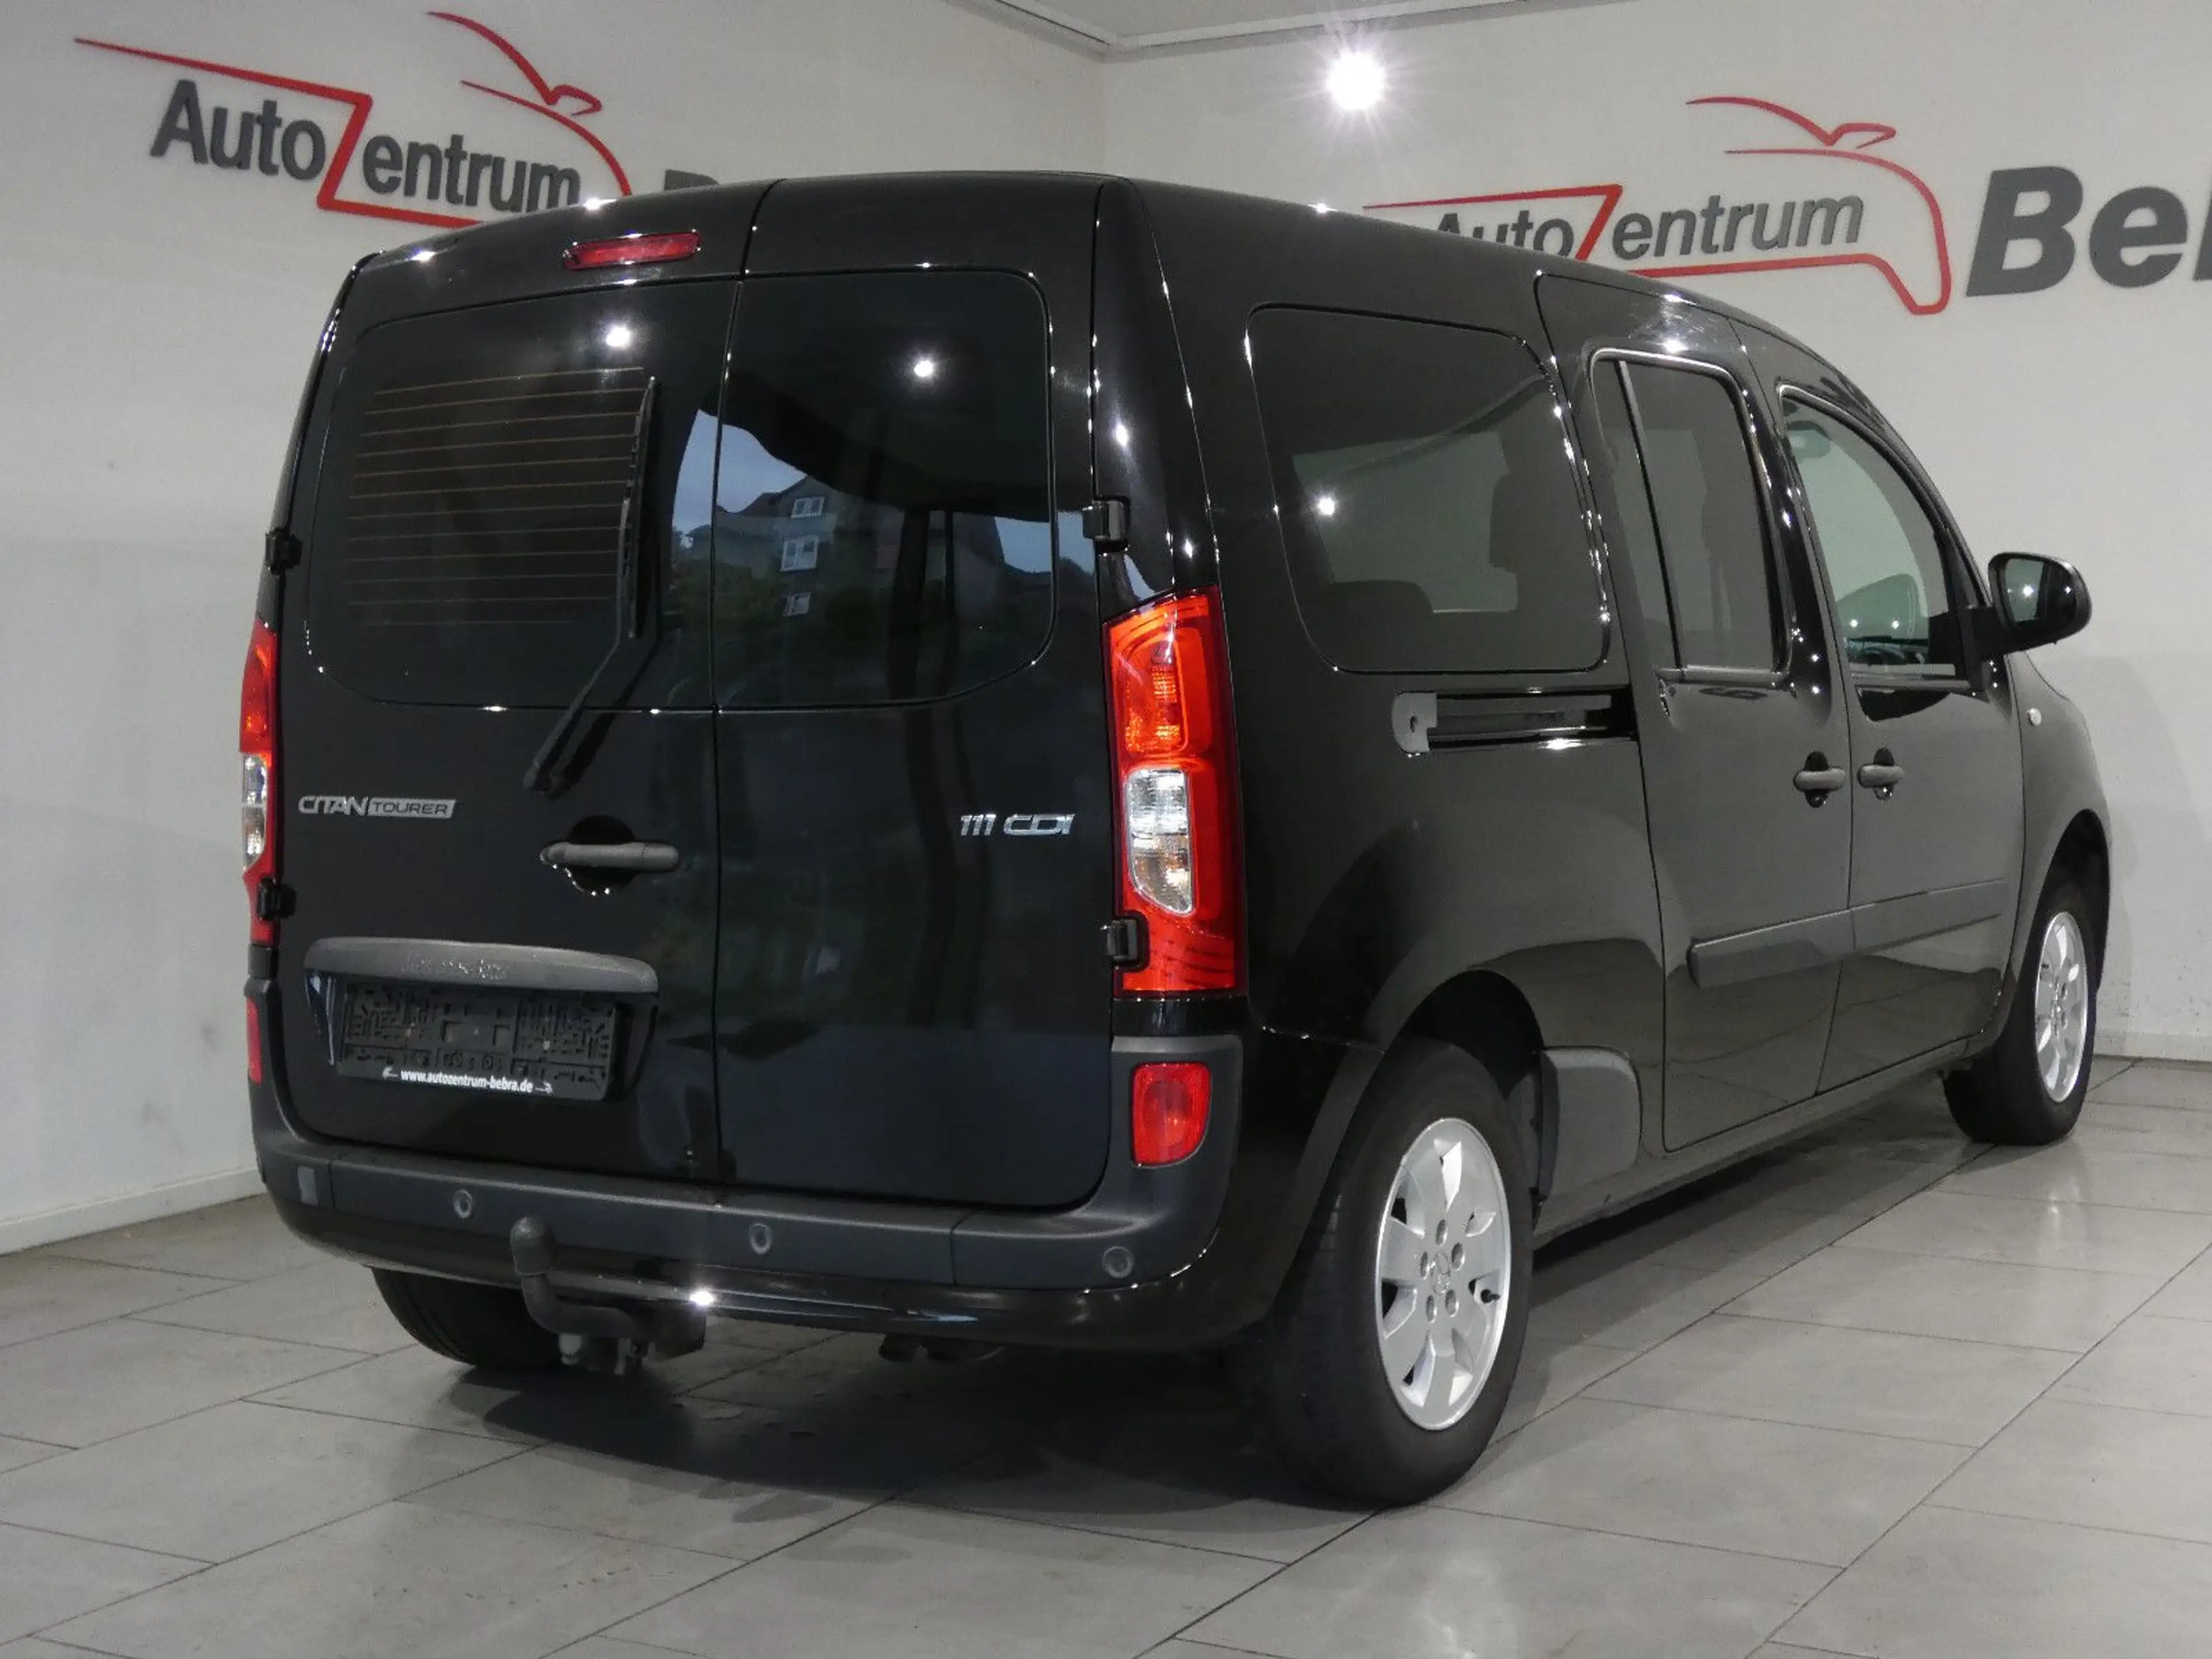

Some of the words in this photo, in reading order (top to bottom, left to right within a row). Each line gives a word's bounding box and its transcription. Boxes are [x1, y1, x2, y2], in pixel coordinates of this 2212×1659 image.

[1965, 165, 2212, 297] Be
[298, 795, 369, 817] CITAN
[371, 799, 452, 817] TOURER
[960, 813, 996, 836] 111
[1003, 813, 1075, 836] CDI
[400, 1069, 533, 1093] www.autozentrum-bebra.de
